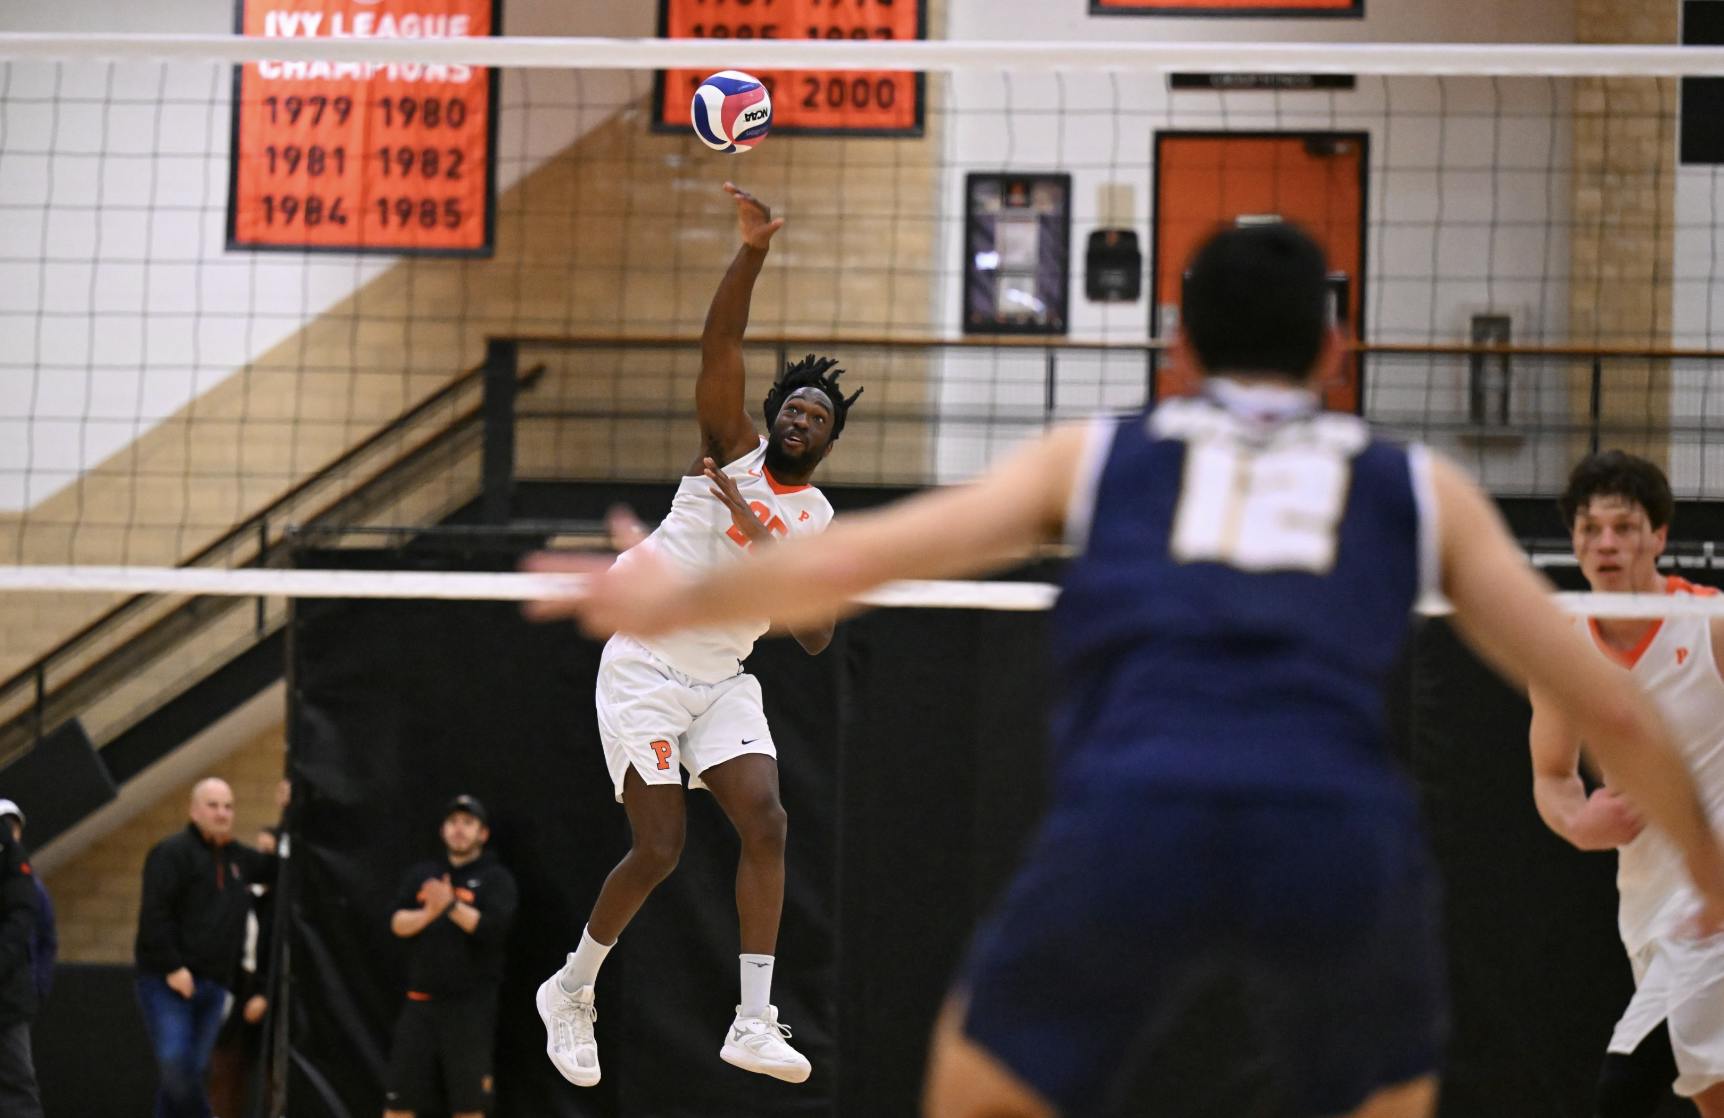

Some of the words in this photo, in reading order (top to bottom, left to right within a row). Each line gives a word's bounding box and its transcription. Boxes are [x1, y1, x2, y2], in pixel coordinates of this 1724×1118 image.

[264, 10, 324, 38] IVY
[331, 12, 471, 39] LEAGUE
[802, 77, 896, 109] 2000
[265, 95, 352, 127] 1979
[379, 97, 466, 129] 1980
[744, 107, 769, 122] NCAA
[264, 145, 346, 177] 1981
[378, 147, 465, 180] 1982
[261, 195, 347, 227] 1984
[376, 196, 462, 229] 1985
[798, 510, 810, 522] P
[1171, 438, 1352, 575] 12
[649, 739, 672, 771] P
